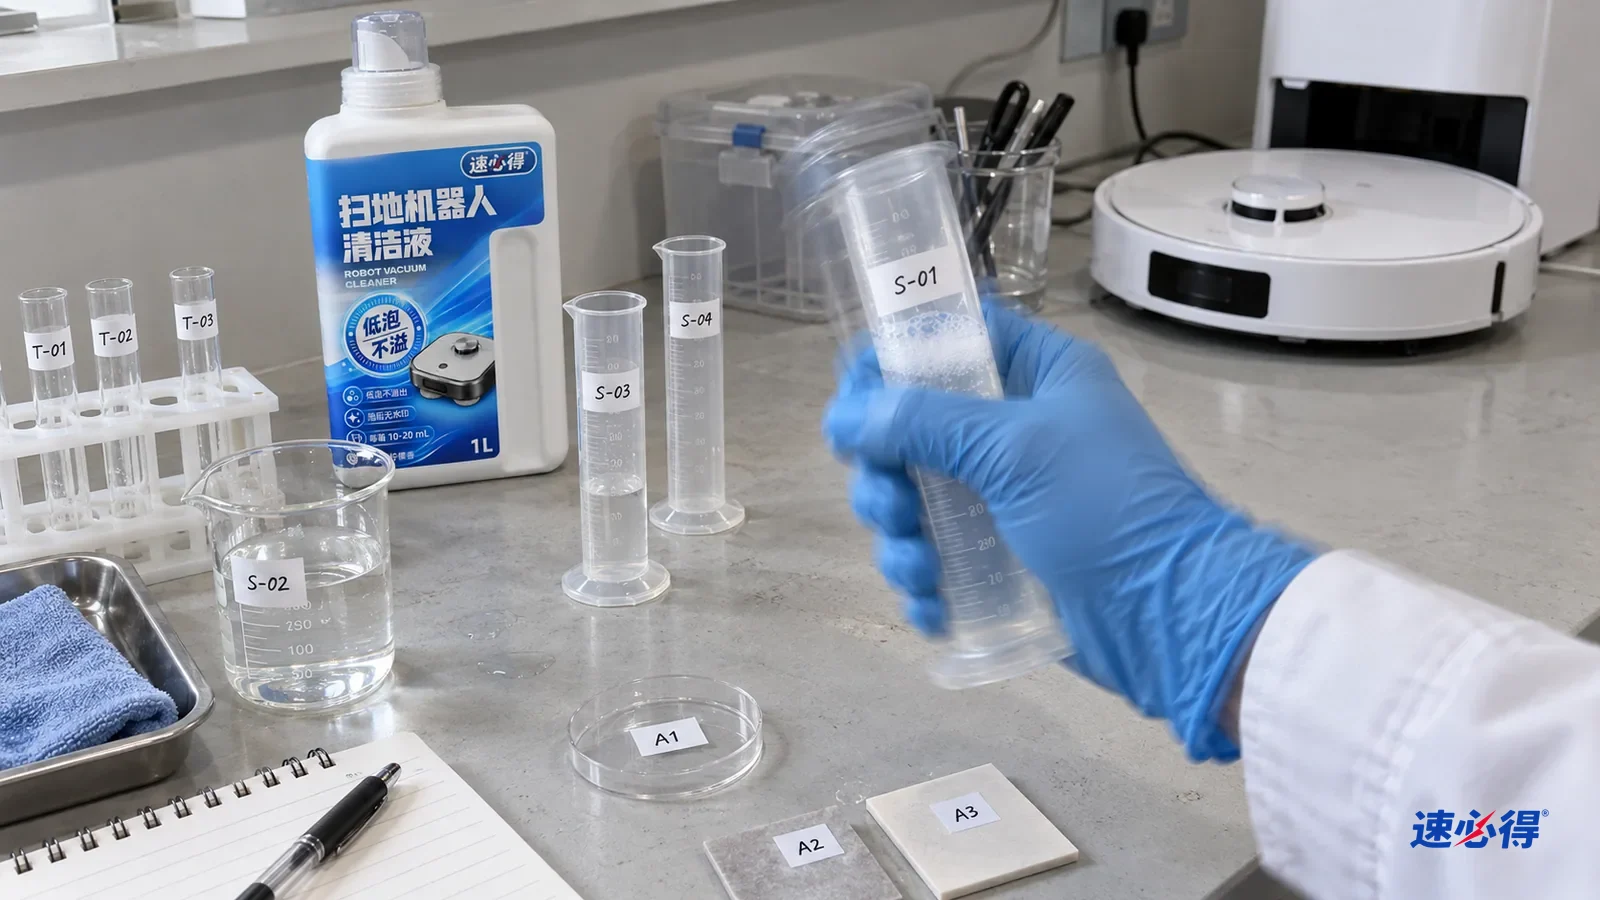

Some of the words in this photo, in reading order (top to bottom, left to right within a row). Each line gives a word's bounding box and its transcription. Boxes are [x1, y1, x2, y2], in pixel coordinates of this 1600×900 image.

[339, 184, 497, 228] 扫地机器人
[343, 227, 433, 263] 清洁液
[344, 267, 381, 278] ROBOT
[384, 264, 426, 274] VACUUM
[345, 278, 397, 288] CLEANER
[894, 266, 937, 295] S-01
[182, 313, 215, 331] T-03
[363, 309, 400, 336] 低泡
[681, 312, 712, 327] S-04
[98, 328, 134, 346] T-02
[372, 332, 408, 358] 不溢
[32, 341, 67, 360] T-01
[595, 384, 631, 400] S-03
[388, 431, 413, 441] 10-20
[415, 429, 429, 438] mL
[471, 437, 493, 454] 1L
[247, 575, 290, 591] S-02
[288, 643, 314, 655] 100
[654, 730, 680, 747] A1
[953, 804, 980, 823] A3
[797, 837, 826, 856] A2
